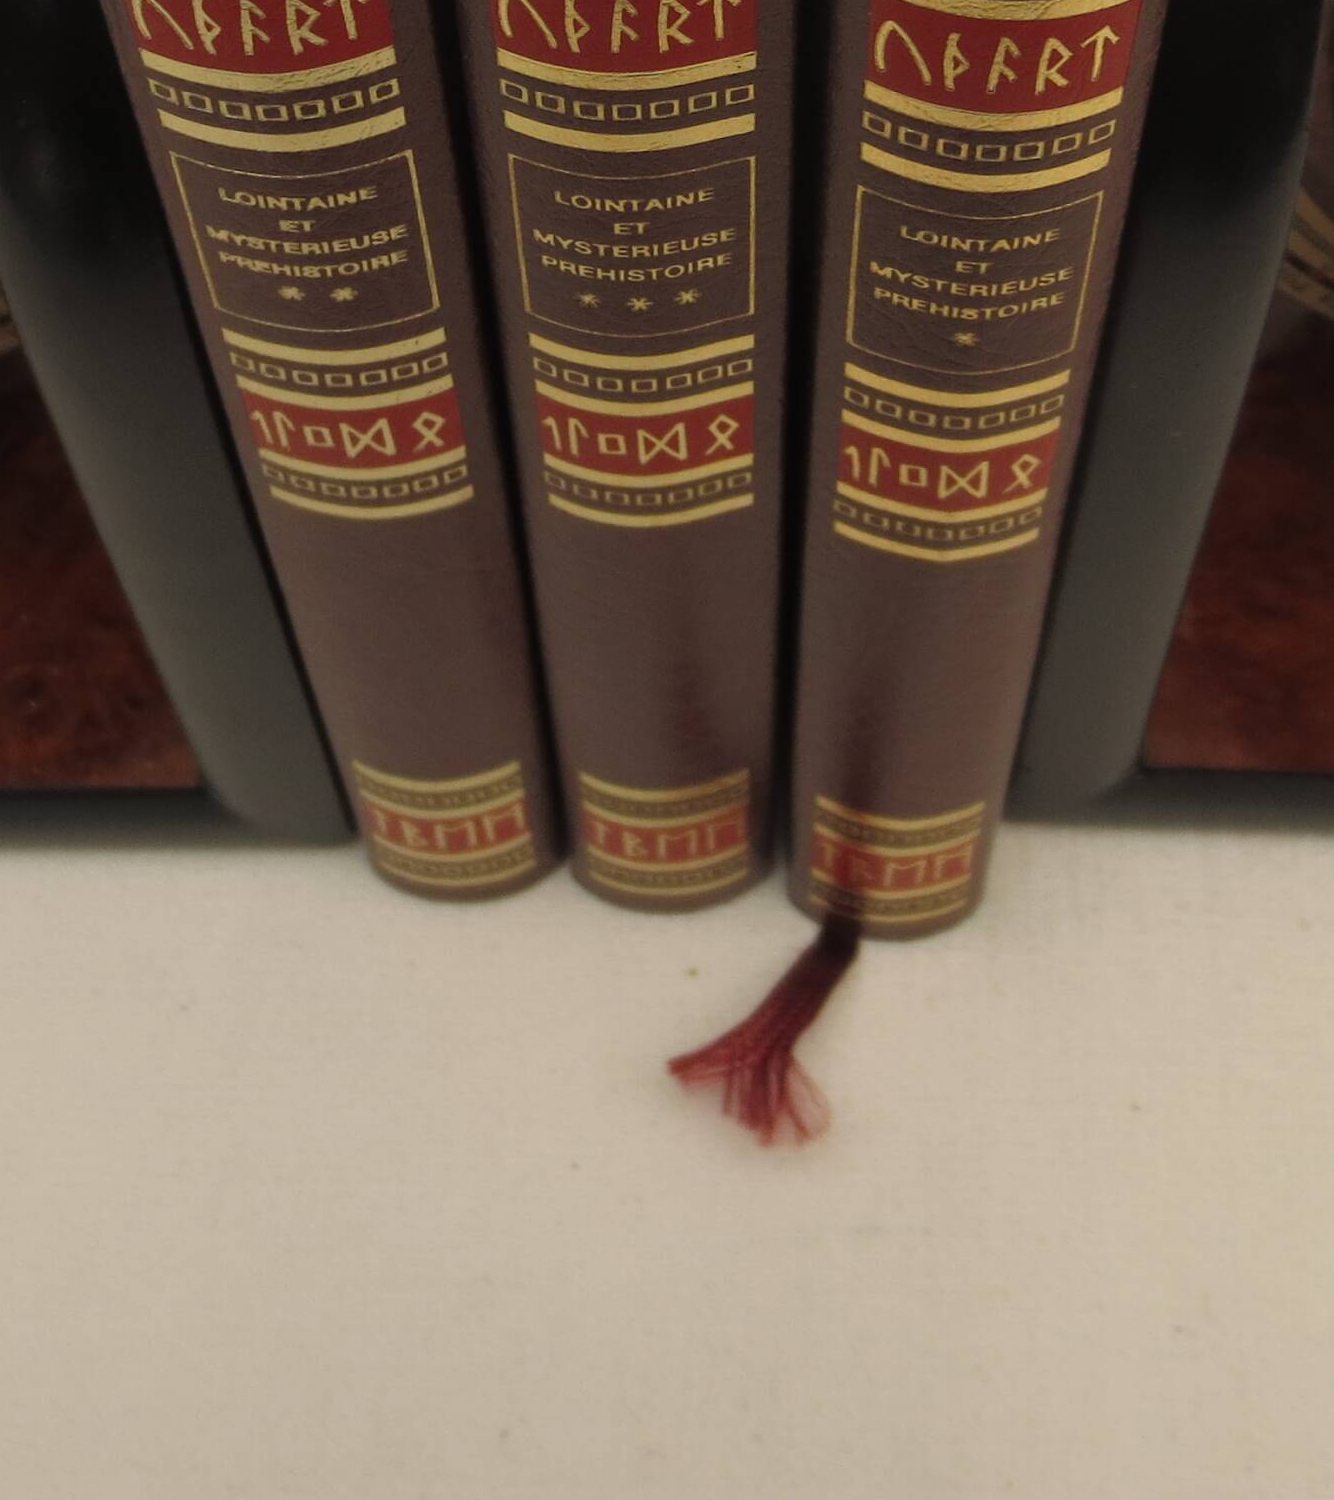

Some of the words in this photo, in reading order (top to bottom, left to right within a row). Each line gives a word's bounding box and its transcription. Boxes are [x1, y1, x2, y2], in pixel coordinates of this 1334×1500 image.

[218, 185, 379, 211] LOINTAINE
[554, 187, 716, 213] LOINTAINE
[205, 223, 410, 256] MYSTERIEUSE
[279, 219, 316, 233] ET
[614, 222, 651, 235] ET
[899, 225, 1061, 252] LOINTAINE
[532, 227, 737, 258] MYSTERIEUSE
[219, 249, 409, 278] PREHISTOIRE
[541, 252, 733, 282] PREHISTOIRE
[955, 261, 994, 274] ET
[870, 260, 1074, 297] MYSTERIEUSE
[873, 287, 1066, 320] PREHISTOIRE
